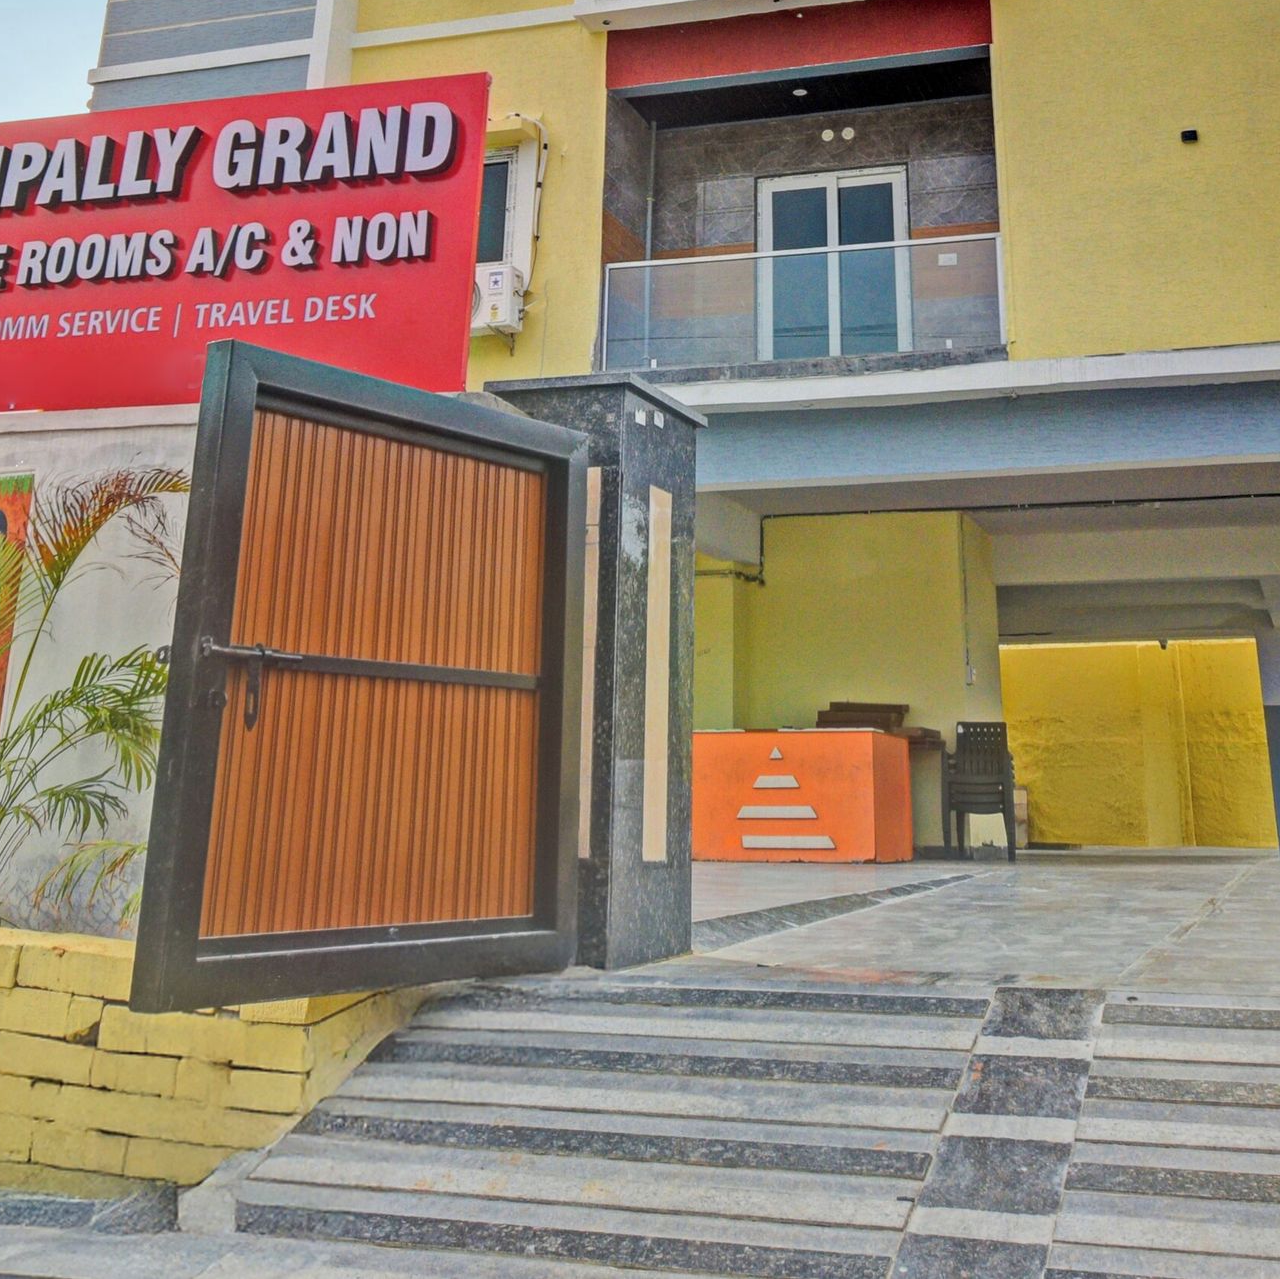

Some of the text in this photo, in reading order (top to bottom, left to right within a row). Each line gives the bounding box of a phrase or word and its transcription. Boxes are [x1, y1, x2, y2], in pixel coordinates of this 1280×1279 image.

[212, 102, 454, 189] GRAND
[16, 229, 174, 286] ROOMS
[185, 221, 266, 277] A/C
[281, 219, 316, 266] &
[331, 210, 429, 263] NON
[56, 306, 163, 338] SERVICE
[194, 296, 295, 329] TRAVEL
[305, 293, 377, 322] DESK
